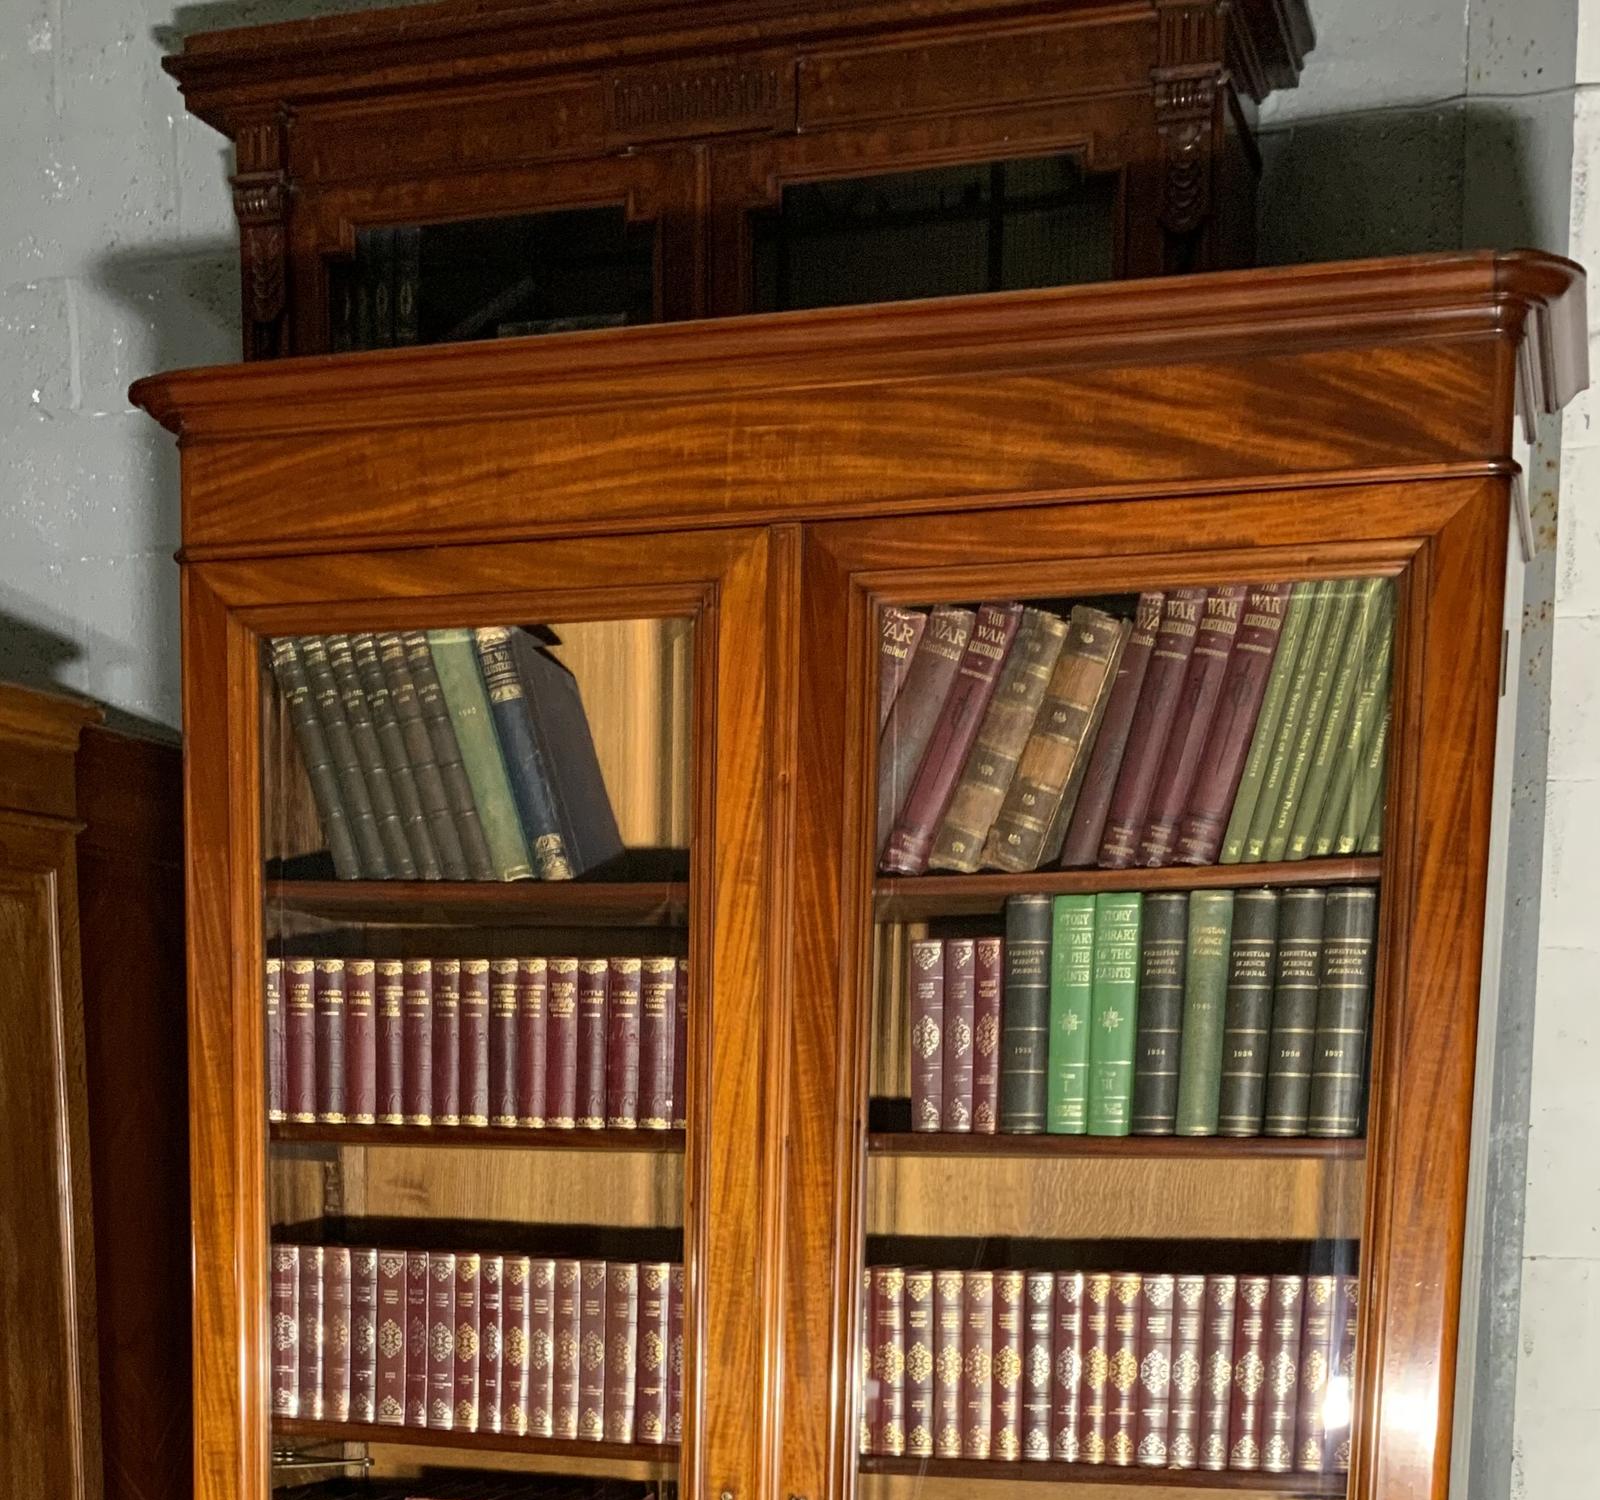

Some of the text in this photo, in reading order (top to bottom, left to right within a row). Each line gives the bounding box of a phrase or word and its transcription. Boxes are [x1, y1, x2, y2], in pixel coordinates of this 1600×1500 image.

[1167, 600, 1197, 622] WAR
[1207, 597, 1239, 619] WAR
[1251, 593, 1282, 615] WAR
[1201, 618, 1238, 635] ILLUSTRATED
[1243, 613, 1282, 631] ILLUSTRATED
[977, 624, 1007, 645] WAR
[1278, 800, 1292, 830] PLACES
[1110, 948, 1134, 960] THE
